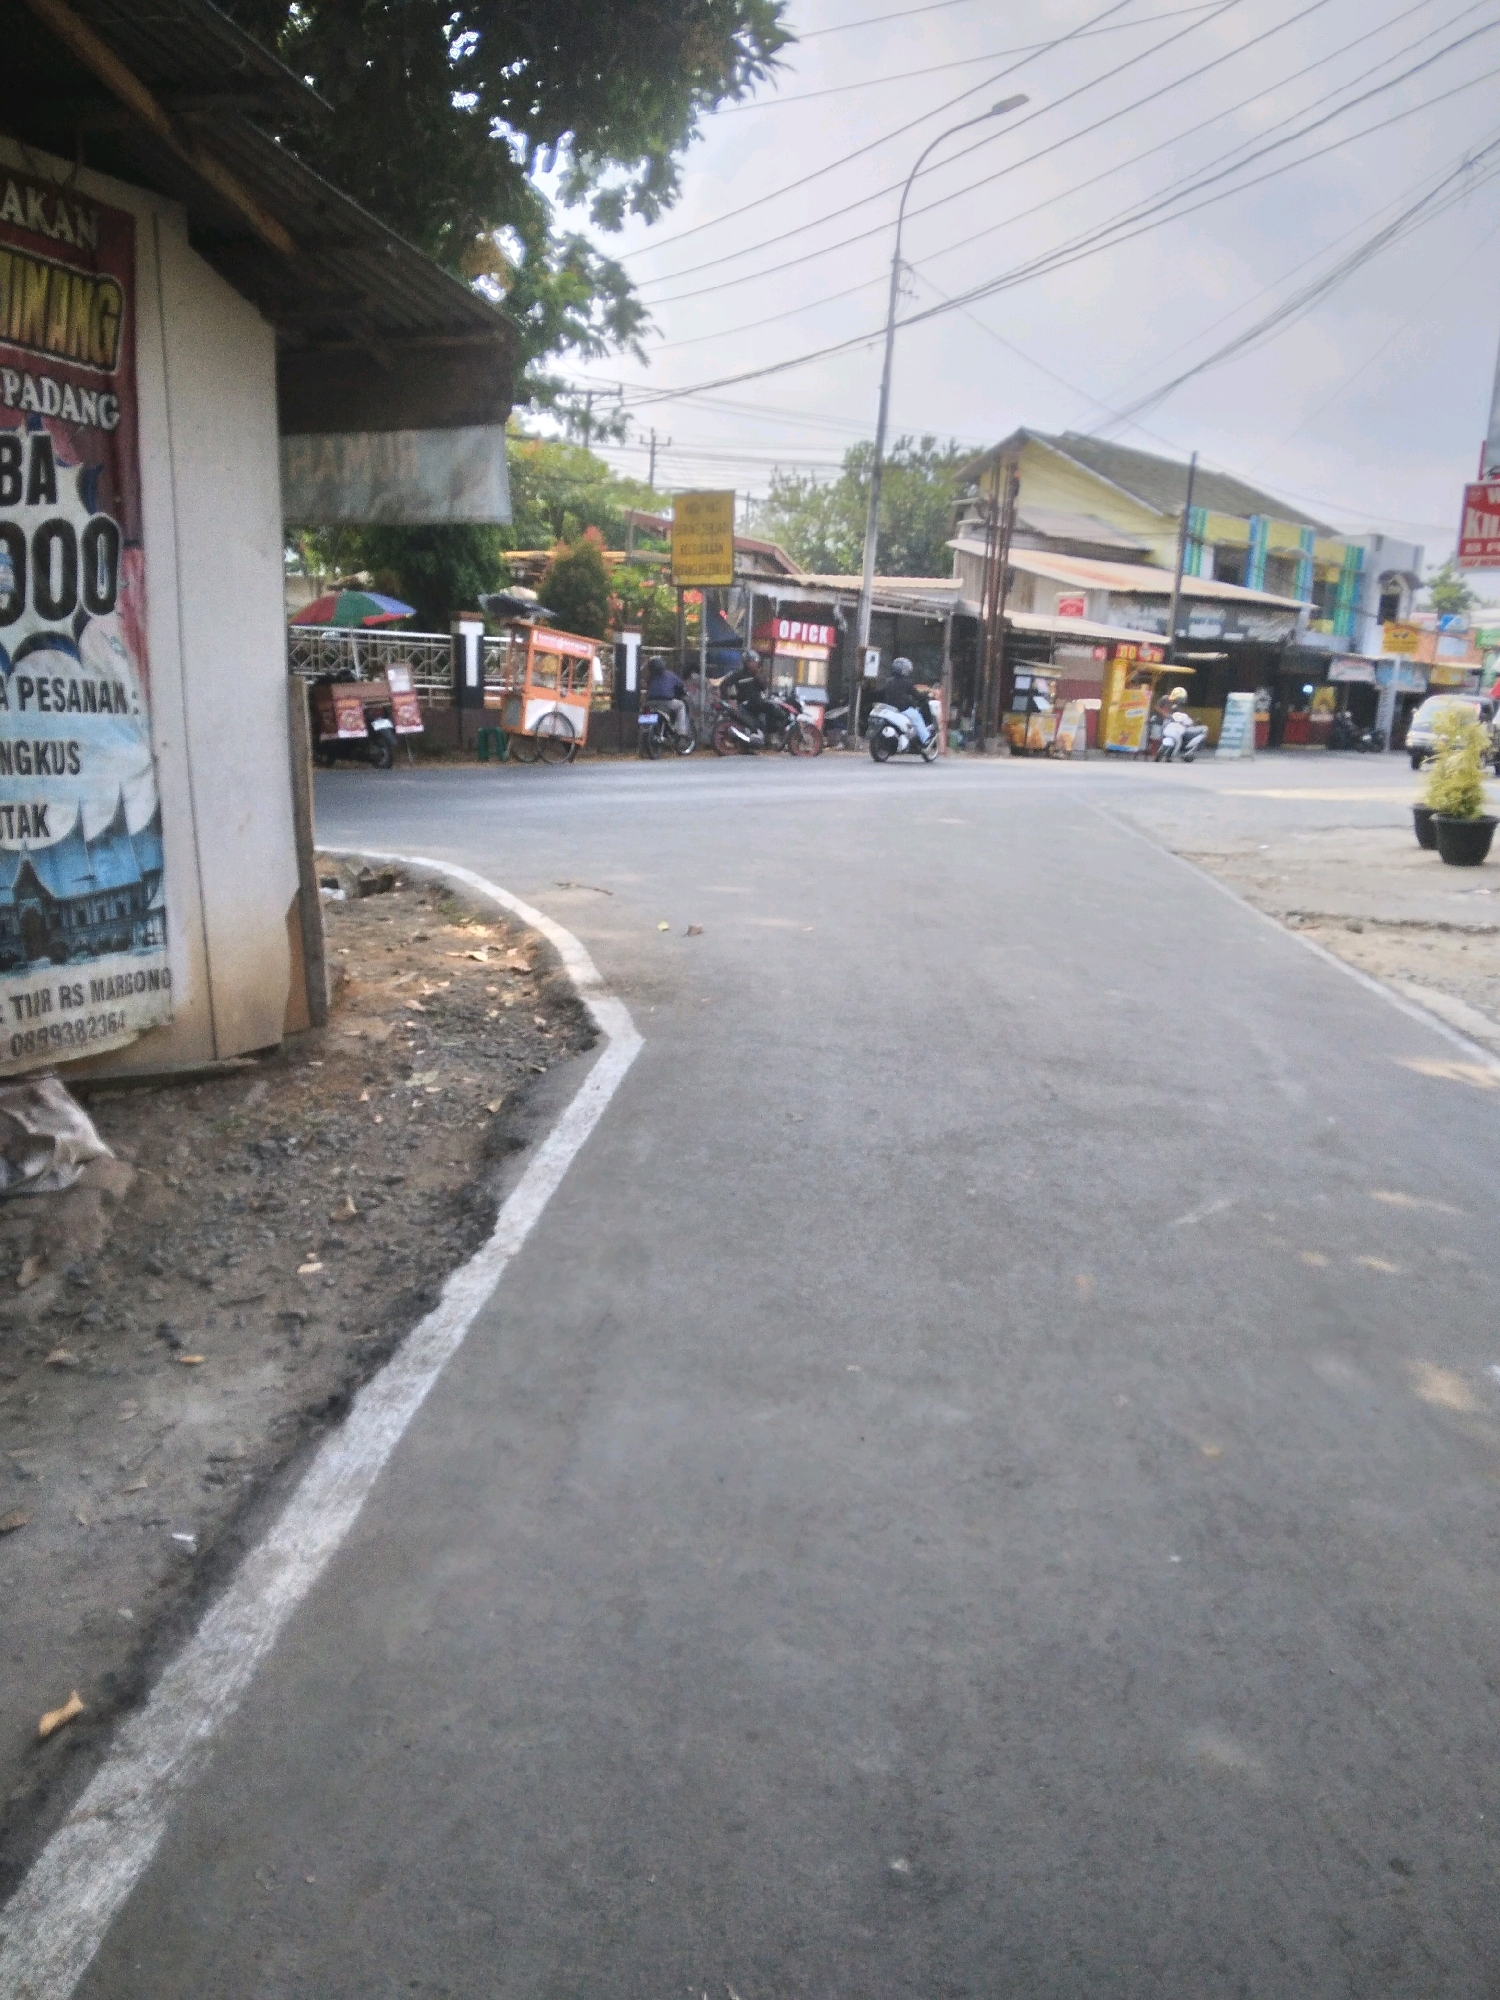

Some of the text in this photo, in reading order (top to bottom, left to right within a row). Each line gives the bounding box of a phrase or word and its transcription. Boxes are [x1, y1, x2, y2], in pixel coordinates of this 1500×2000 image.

[2, 368, 120, 430] PADANG
[779, 619, 828, 645] OPICK
[58, 982, 84, 1010] RS
